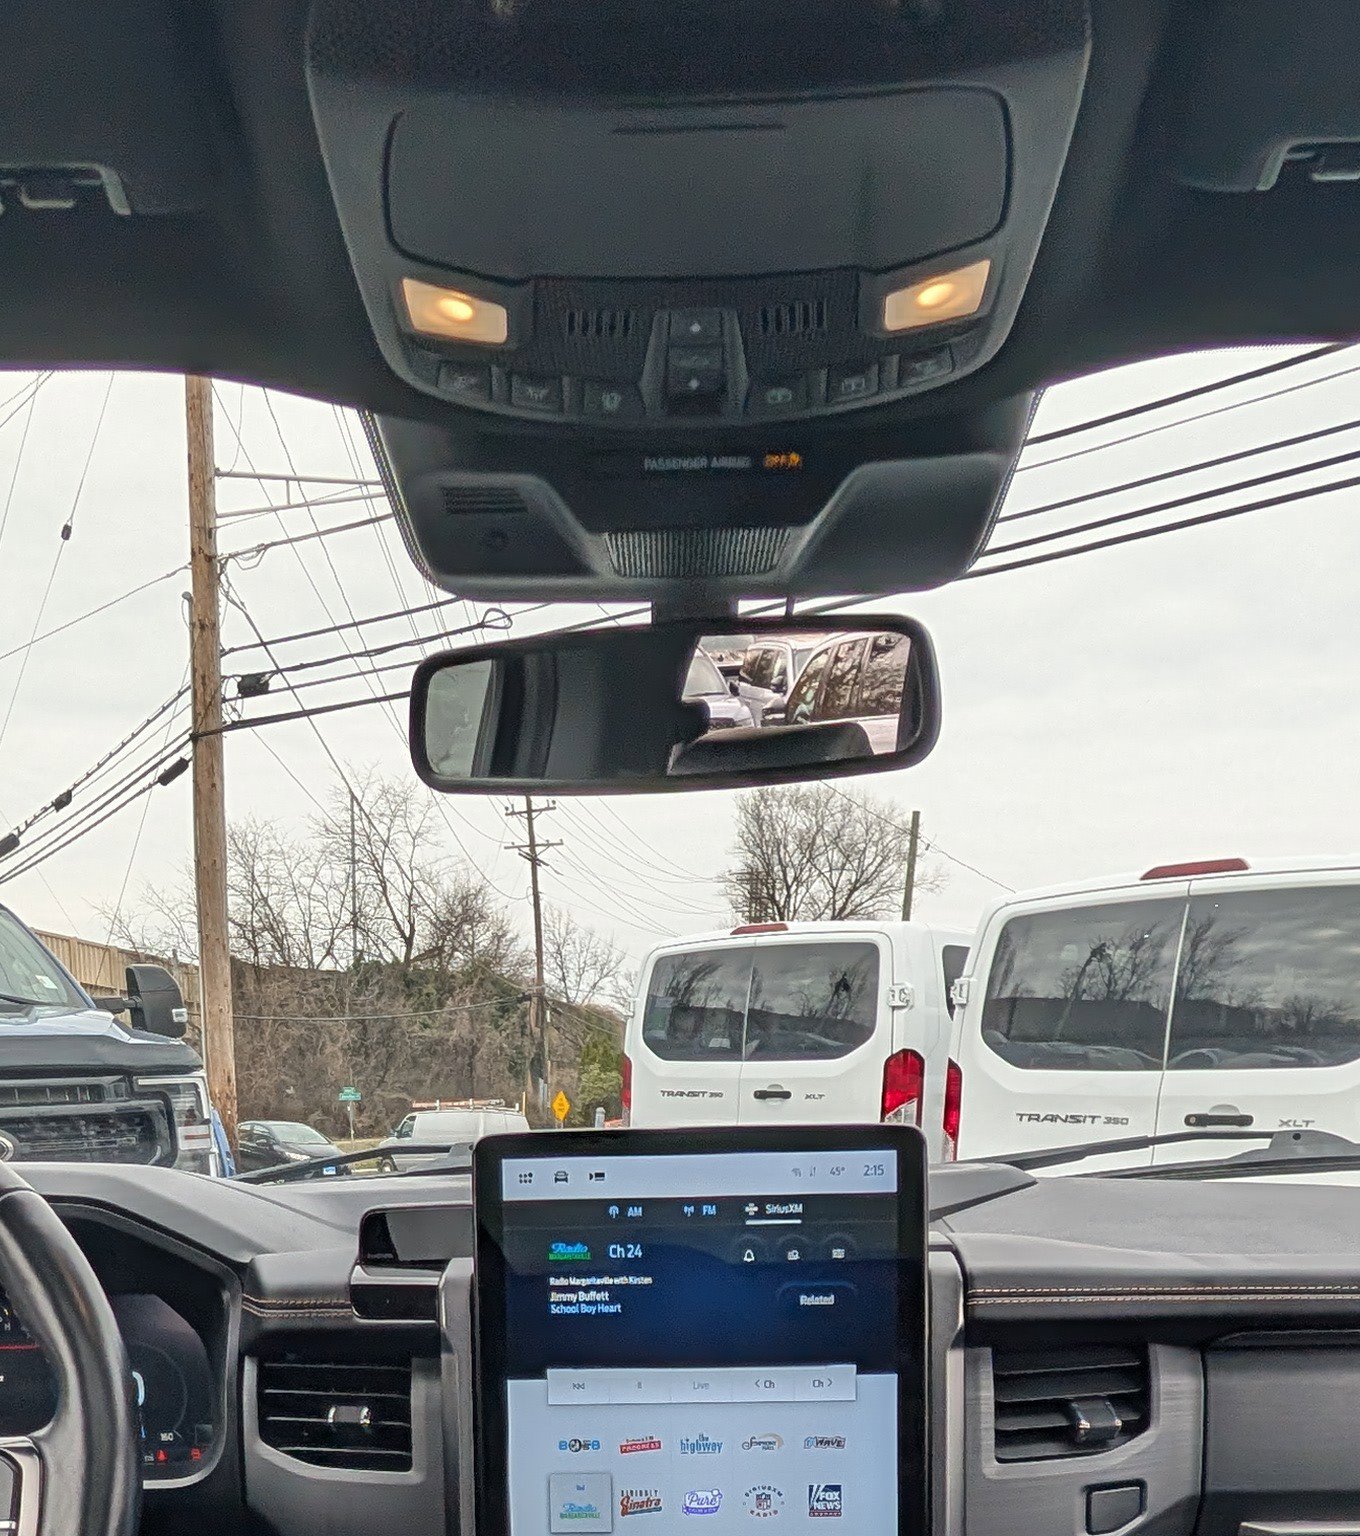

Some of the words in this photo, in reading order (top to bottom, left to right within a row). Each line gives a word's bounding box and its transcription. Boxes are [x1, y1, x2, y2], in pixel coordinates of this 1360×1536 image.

[660, 1089, 708, 1099] TRANSIT
[804, 1092, 826, 1100] XLT
[1016, 1112, 1102, 1125] TRANSIT
[1103, 1115, 1130, 1127] 350
[1278, 1118, 1316, 1129] XLT
[863, 1164, 885, 1177] 2:15
[627, 1205, 643, 1218] AM
[702, 1204, 717, 1217] FM
[765, 1202, 804, 1215] SiriusXM
[608, 1244, 626, 1259] Ch
[627, 1243, 644, 1259] 24
[549, 1276, 569, 1286] Radio
[550, 1291, 577, 1303] Jimmy
[578, 1290, 610, 1302] Buffett
[799, 1294, 835, 1306] Related
[550, 1303, 580, 1314] School
[580, 1303, 597, 1315] Boy
[597, 1302, 622, 1314] Heart
[693, 1380, 710, 1390] Live
[763, 1379, 776, 1389] Ch
[812, 1378, 825, 1389] Ch
[680, 1438, 724, 1455] highway
[819, 1491, 840, 1501] FOX
[619, 1496, 662, 1516] Sinatra
[812, 1500, 841, 1510] NEWS
